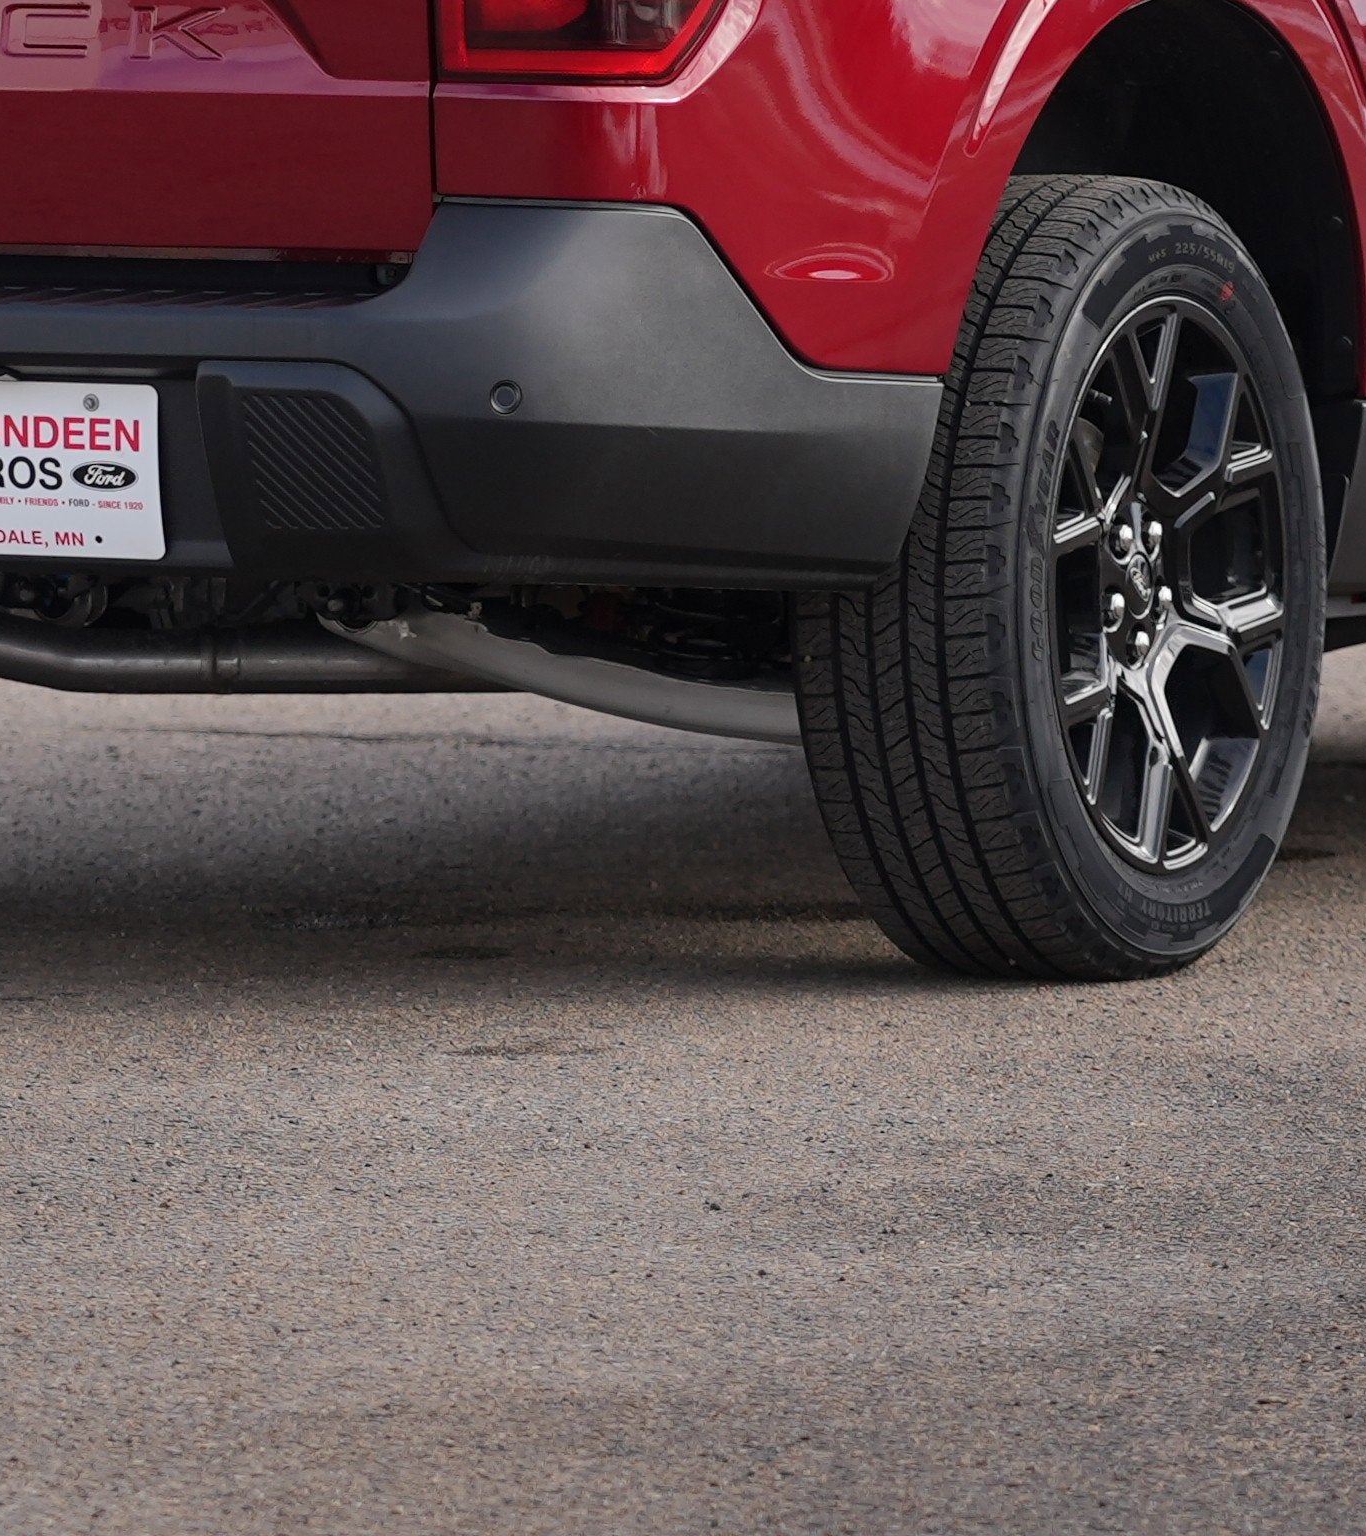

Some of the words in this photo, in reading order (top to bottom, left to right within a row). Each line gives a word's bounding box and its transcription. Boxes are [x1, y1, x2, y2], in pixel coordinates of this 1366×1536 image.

[82, 463, 126, 488] Ford
[24, 497, 59, 507] FRIENDS
[68, 498, 90, 508] FORD
[97, 499, 122, 510] SINCE
[55, 531, 85, 547] MN
[1139, 899, 1213, 924] TERRITORY
